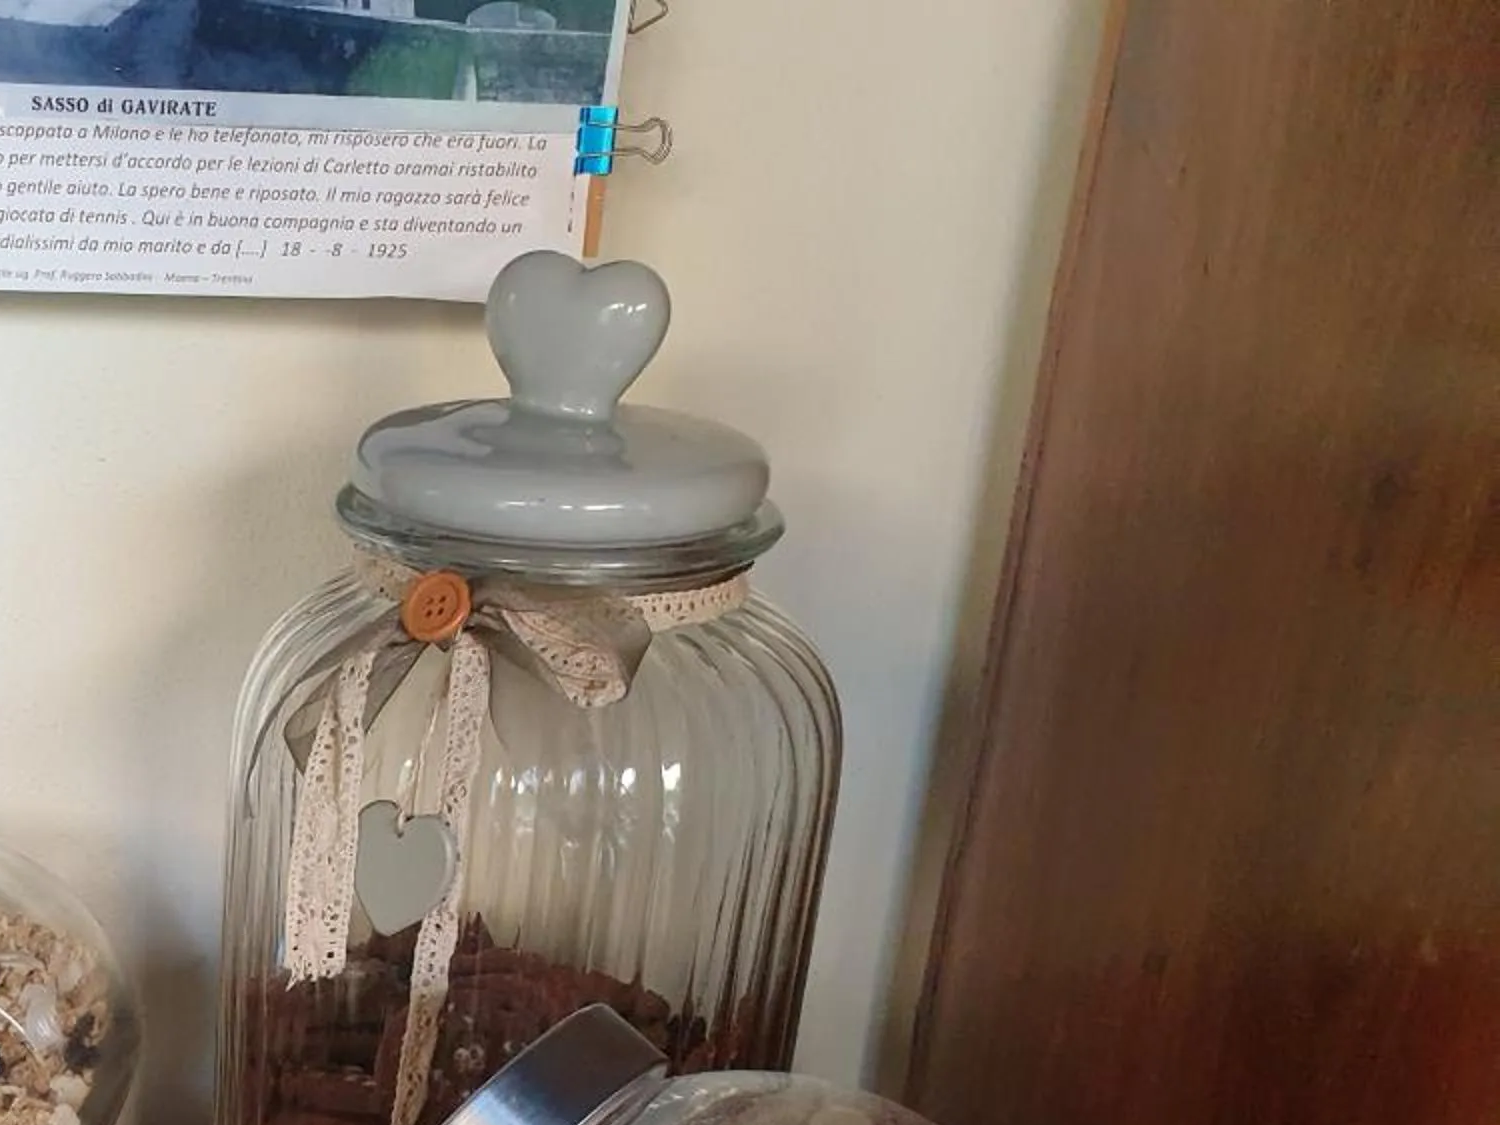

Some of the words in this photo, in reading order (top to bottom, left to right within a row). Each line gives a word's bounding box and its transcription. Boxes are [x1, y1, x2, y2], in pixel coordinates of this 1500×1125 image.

[31, 96, 89, 112] SASSO
[97, 98, 113, 113] di
[121, 99, 218, 117] GAVIRATE
[0, 124, 73, 140] scappata
[77, 127, 88, 138] a
[92, 124, 151, 140] Milano
[155, 129, 165, 140] e
[169, 127, 183, 141] le
[187, 128, 209, 142] ho
[213, 128, 301, 146] telefonato,
[307, 131, 330, 145] mi
[333, 131, 409, 149] risposero
[413, 132, 443, 148] che
[447, 136, 475, 149] era
[476, 134, 522, 153] fuori.
[528, 135, 548, 151] La
[8, 152, 36, 168] per
[39, 152, 107, 168] mettersi
[196, 158, 224, 174] per
[227, 155, 243, 171] le
[247, 157, 299, 173] lezioni
[303, 158, 319, 173] di
[323, 158, 389, 175] Carletto
[457, 161, 538, 178] ristabilito
[6, 179, 62, 197] gentile
[66, 179, 113, 197] aiuto.
[117, 181, 138, 197] La
[140, 184, 186, 201] spero
[191, 183, 231, 199] bene
[235, 187, 245, 200] e
[249, 187, 319, 204] riposato.
[340, 188, 371, 203] mio
[375, 190, 441, 207] ragazzo
[444, 189, 482, 205] sarà
[483, 189, 531, 208] felice
[59, 207, 75, 223] di
[78, 210, 128, 226] tennis
[141, 210, 171, 227] Qui
[174, 211, 185, 227] è
[188, 212, 203, 227] in
[207, 212, 259, 229] buona
[263, 215, 355, 233] compagnia
[359, 218, 369, 231] e
[373, 217, 400, 232] sta
[403, 215, 497, 234] diventando
[500, 219, 523, 234] un
[77, 237, 98, 252] da
[103, 238, 133, 253] mio
[137, 238, 193, 255] marito
[196, 242, 207, 255] e
[210, 240, 231, 256] da
[280, 241, 302, 257] 18
[367, 243, 408, 259] 1925
